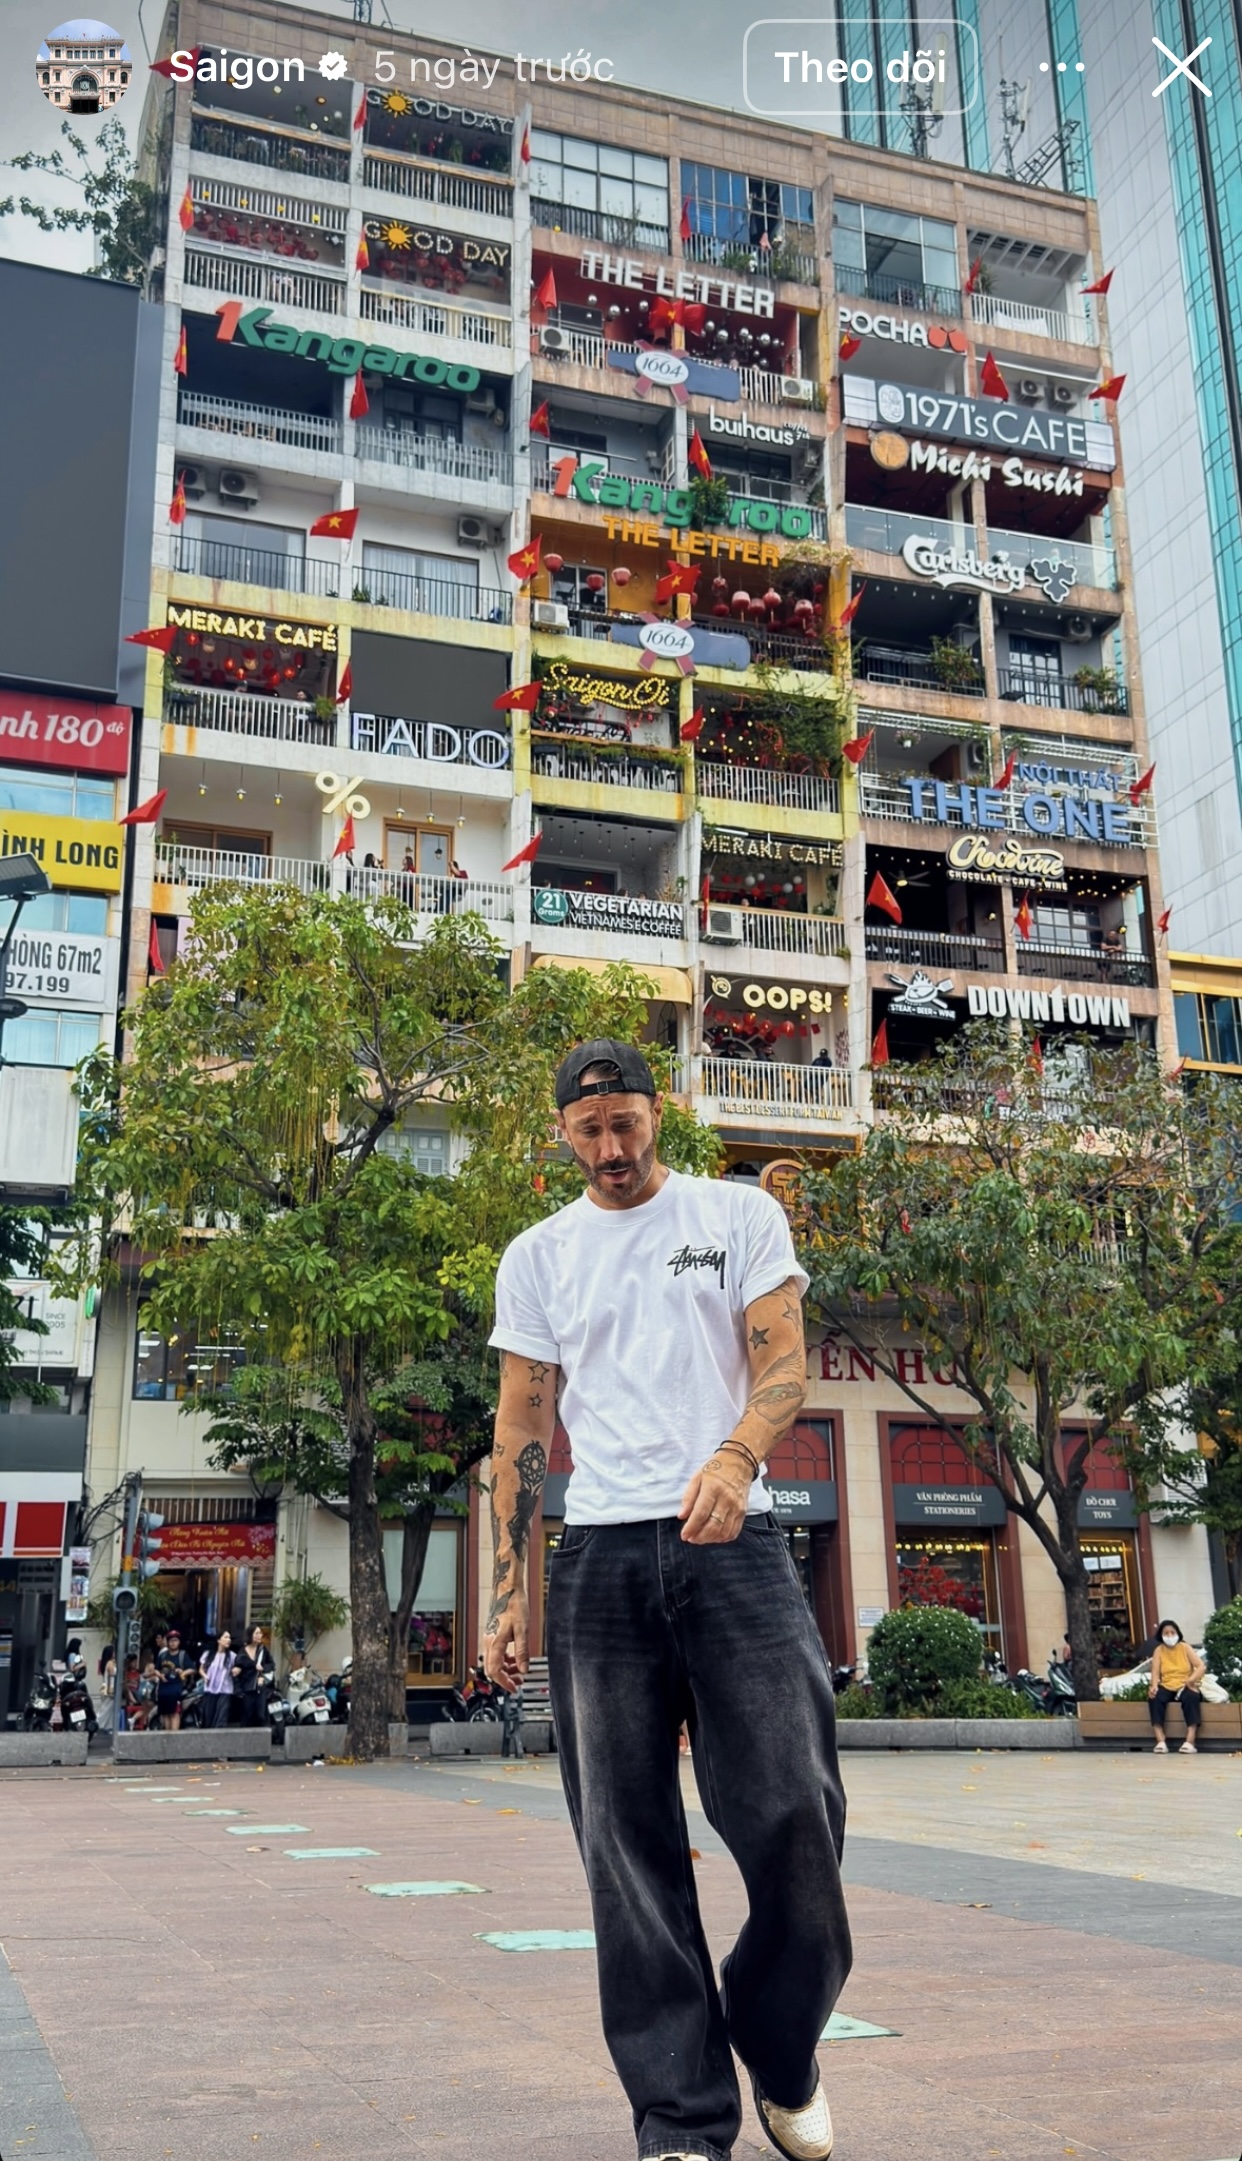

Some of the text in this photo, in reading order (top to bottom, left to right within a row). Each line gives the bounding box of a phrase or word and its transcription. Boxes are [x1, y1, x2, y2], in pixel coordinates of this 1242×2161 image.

[463, 241, 509, 267] DAY
[582, 250, 775, 319] THE LETTER
[838, 306, 928, 347] POCHA
[642, 357, 683, 378] 1664
[709, 404, 794, 446] buihaus
[905, 392, 1086, 457] 1971's CAFE
[911, 440, 1084, 497] Michi Sushi
[551, 456, 812, 538] Kangroo
[603, 515, 780, 568] THE LETTER
[903, 534, 1026, 595] Carlsberg
[168, 606, 338, 651] MERAKI CAFÉ
[646, 629, 688, 649] 1664
[44, 714, 104, 747] 180
[352, 712, 510, 769] FADO
[904, 778, 1132, 843] THE ONE
[55, 840, 119, 870] LONG
[701, 835, 843, 867] MERAKI CAFÉ
[948, 870, 1003, 884] CHOCOLATE
[538, 907, 565, 917] Grams
[541, 891, 562, 909] 21
[569, 891, 684, 921] VEGETARIAN
[570, 911, 682, 936] VIETNAMESE COFFEE
[57, 944, 102, 975] 67m2
